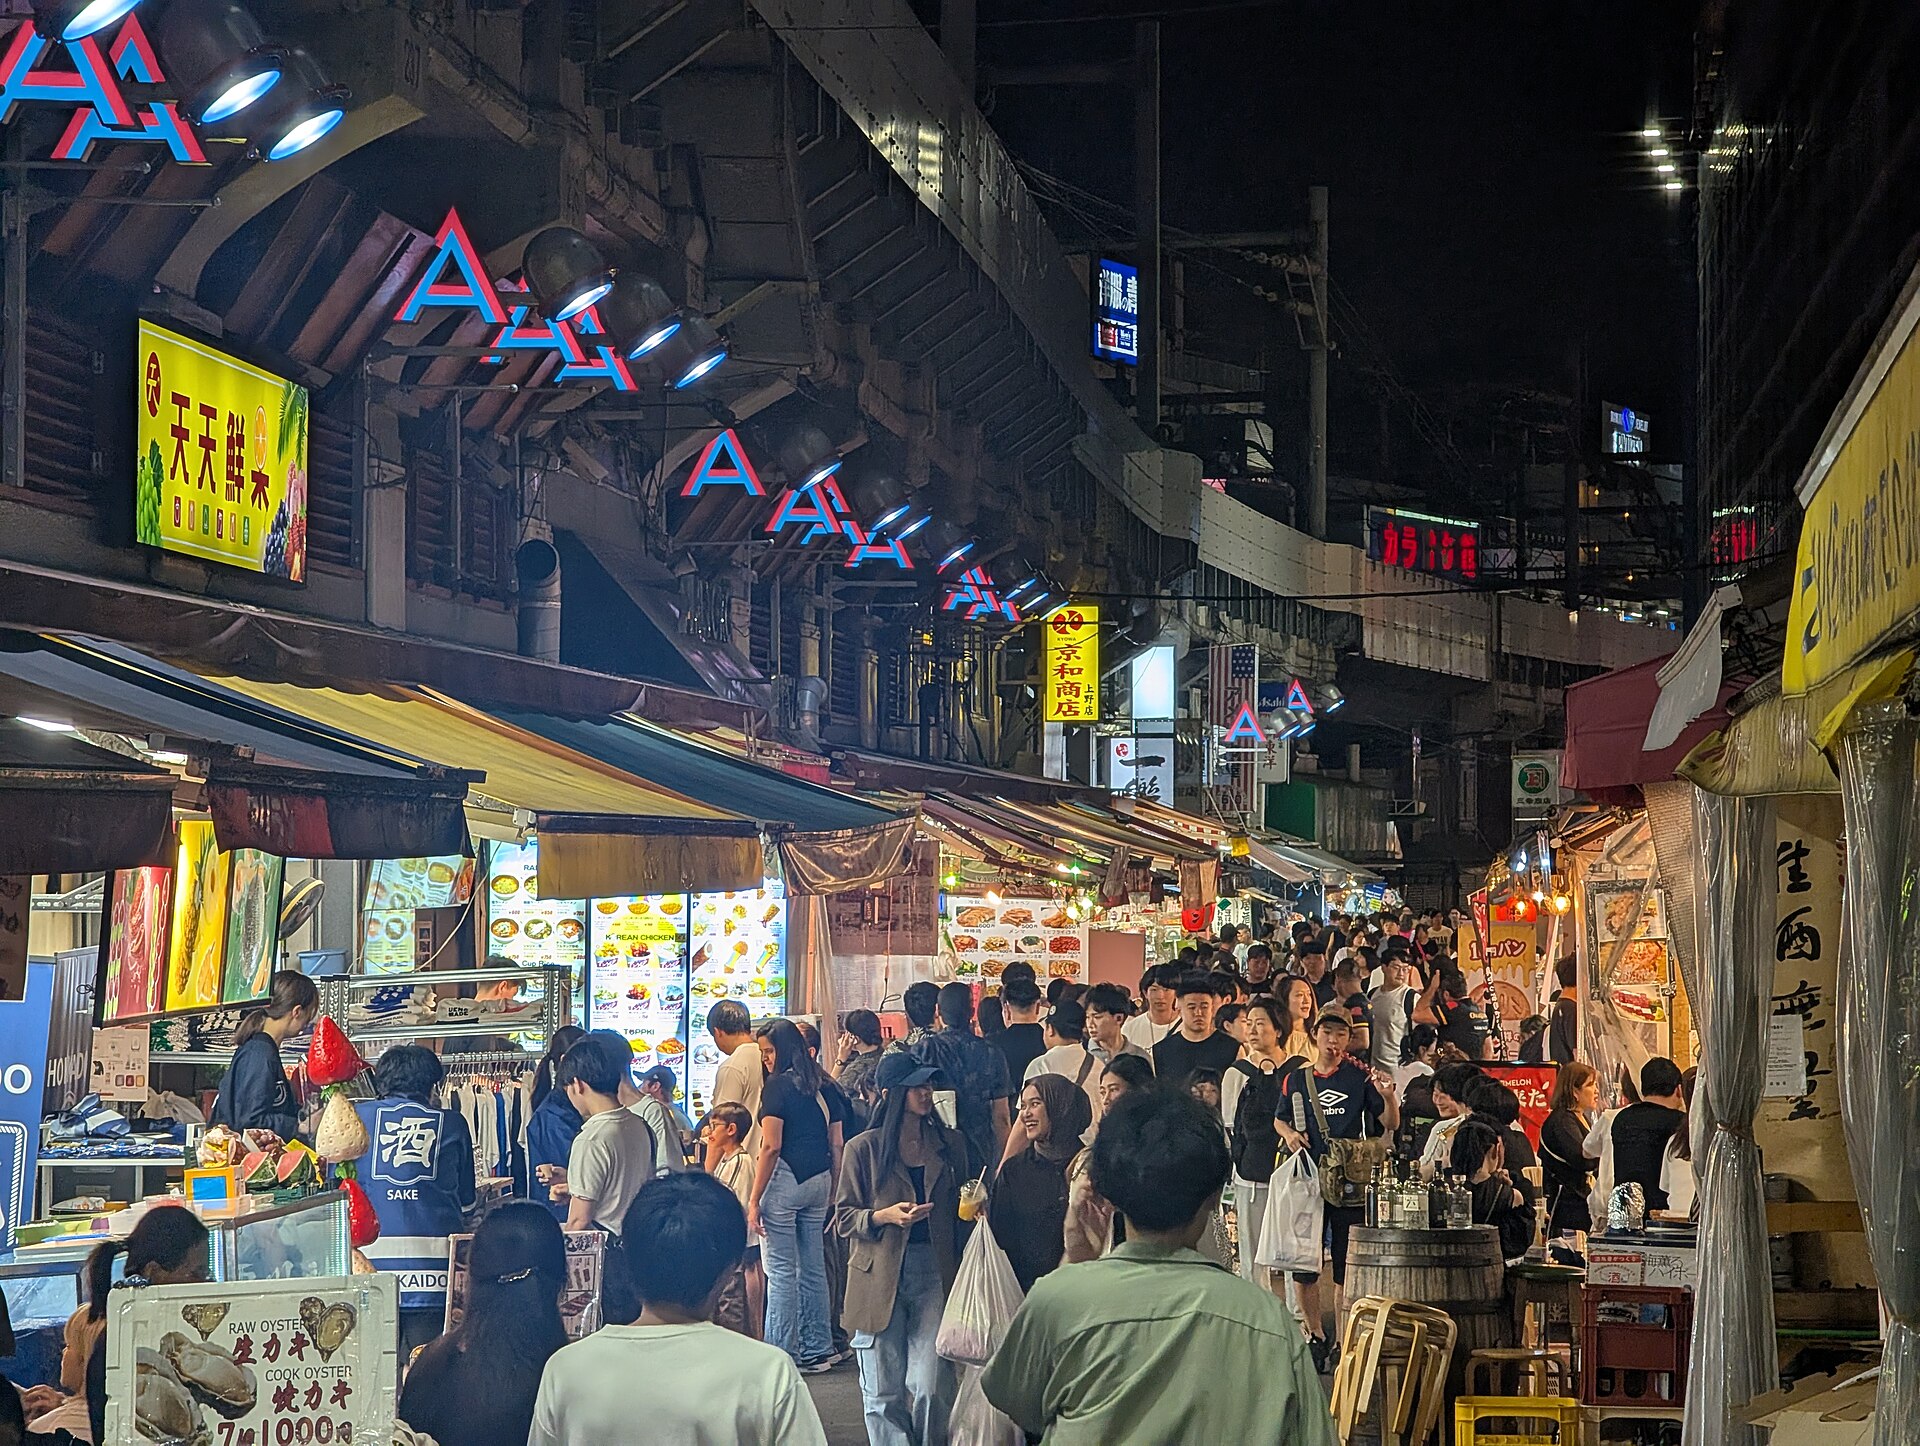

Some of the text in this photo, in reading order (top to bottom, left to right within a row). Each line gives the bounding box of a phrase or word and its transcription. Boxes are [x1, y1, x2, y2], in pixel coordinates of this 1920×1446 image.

[393, 206, 508, 323] A
[680, 428, 766, 496] A
[1052, 643, 1083, 717] 京和商店
[1083, 683, 1095, 716] 上野店
[1225, 700, 1267, 742] A
[0, 1063, 33, 1095] O
[1321, 1106, 1346, 1115] mbro
[380, 1116, 437, 1168] 酒
[387, 1189, 419, 1200] SAKE
[229, 1321, 257, 1335] RAW
[232, 1331, 311, 1367] 生カキ
[265, 1365, 353, 1382] COOK OYSTER
